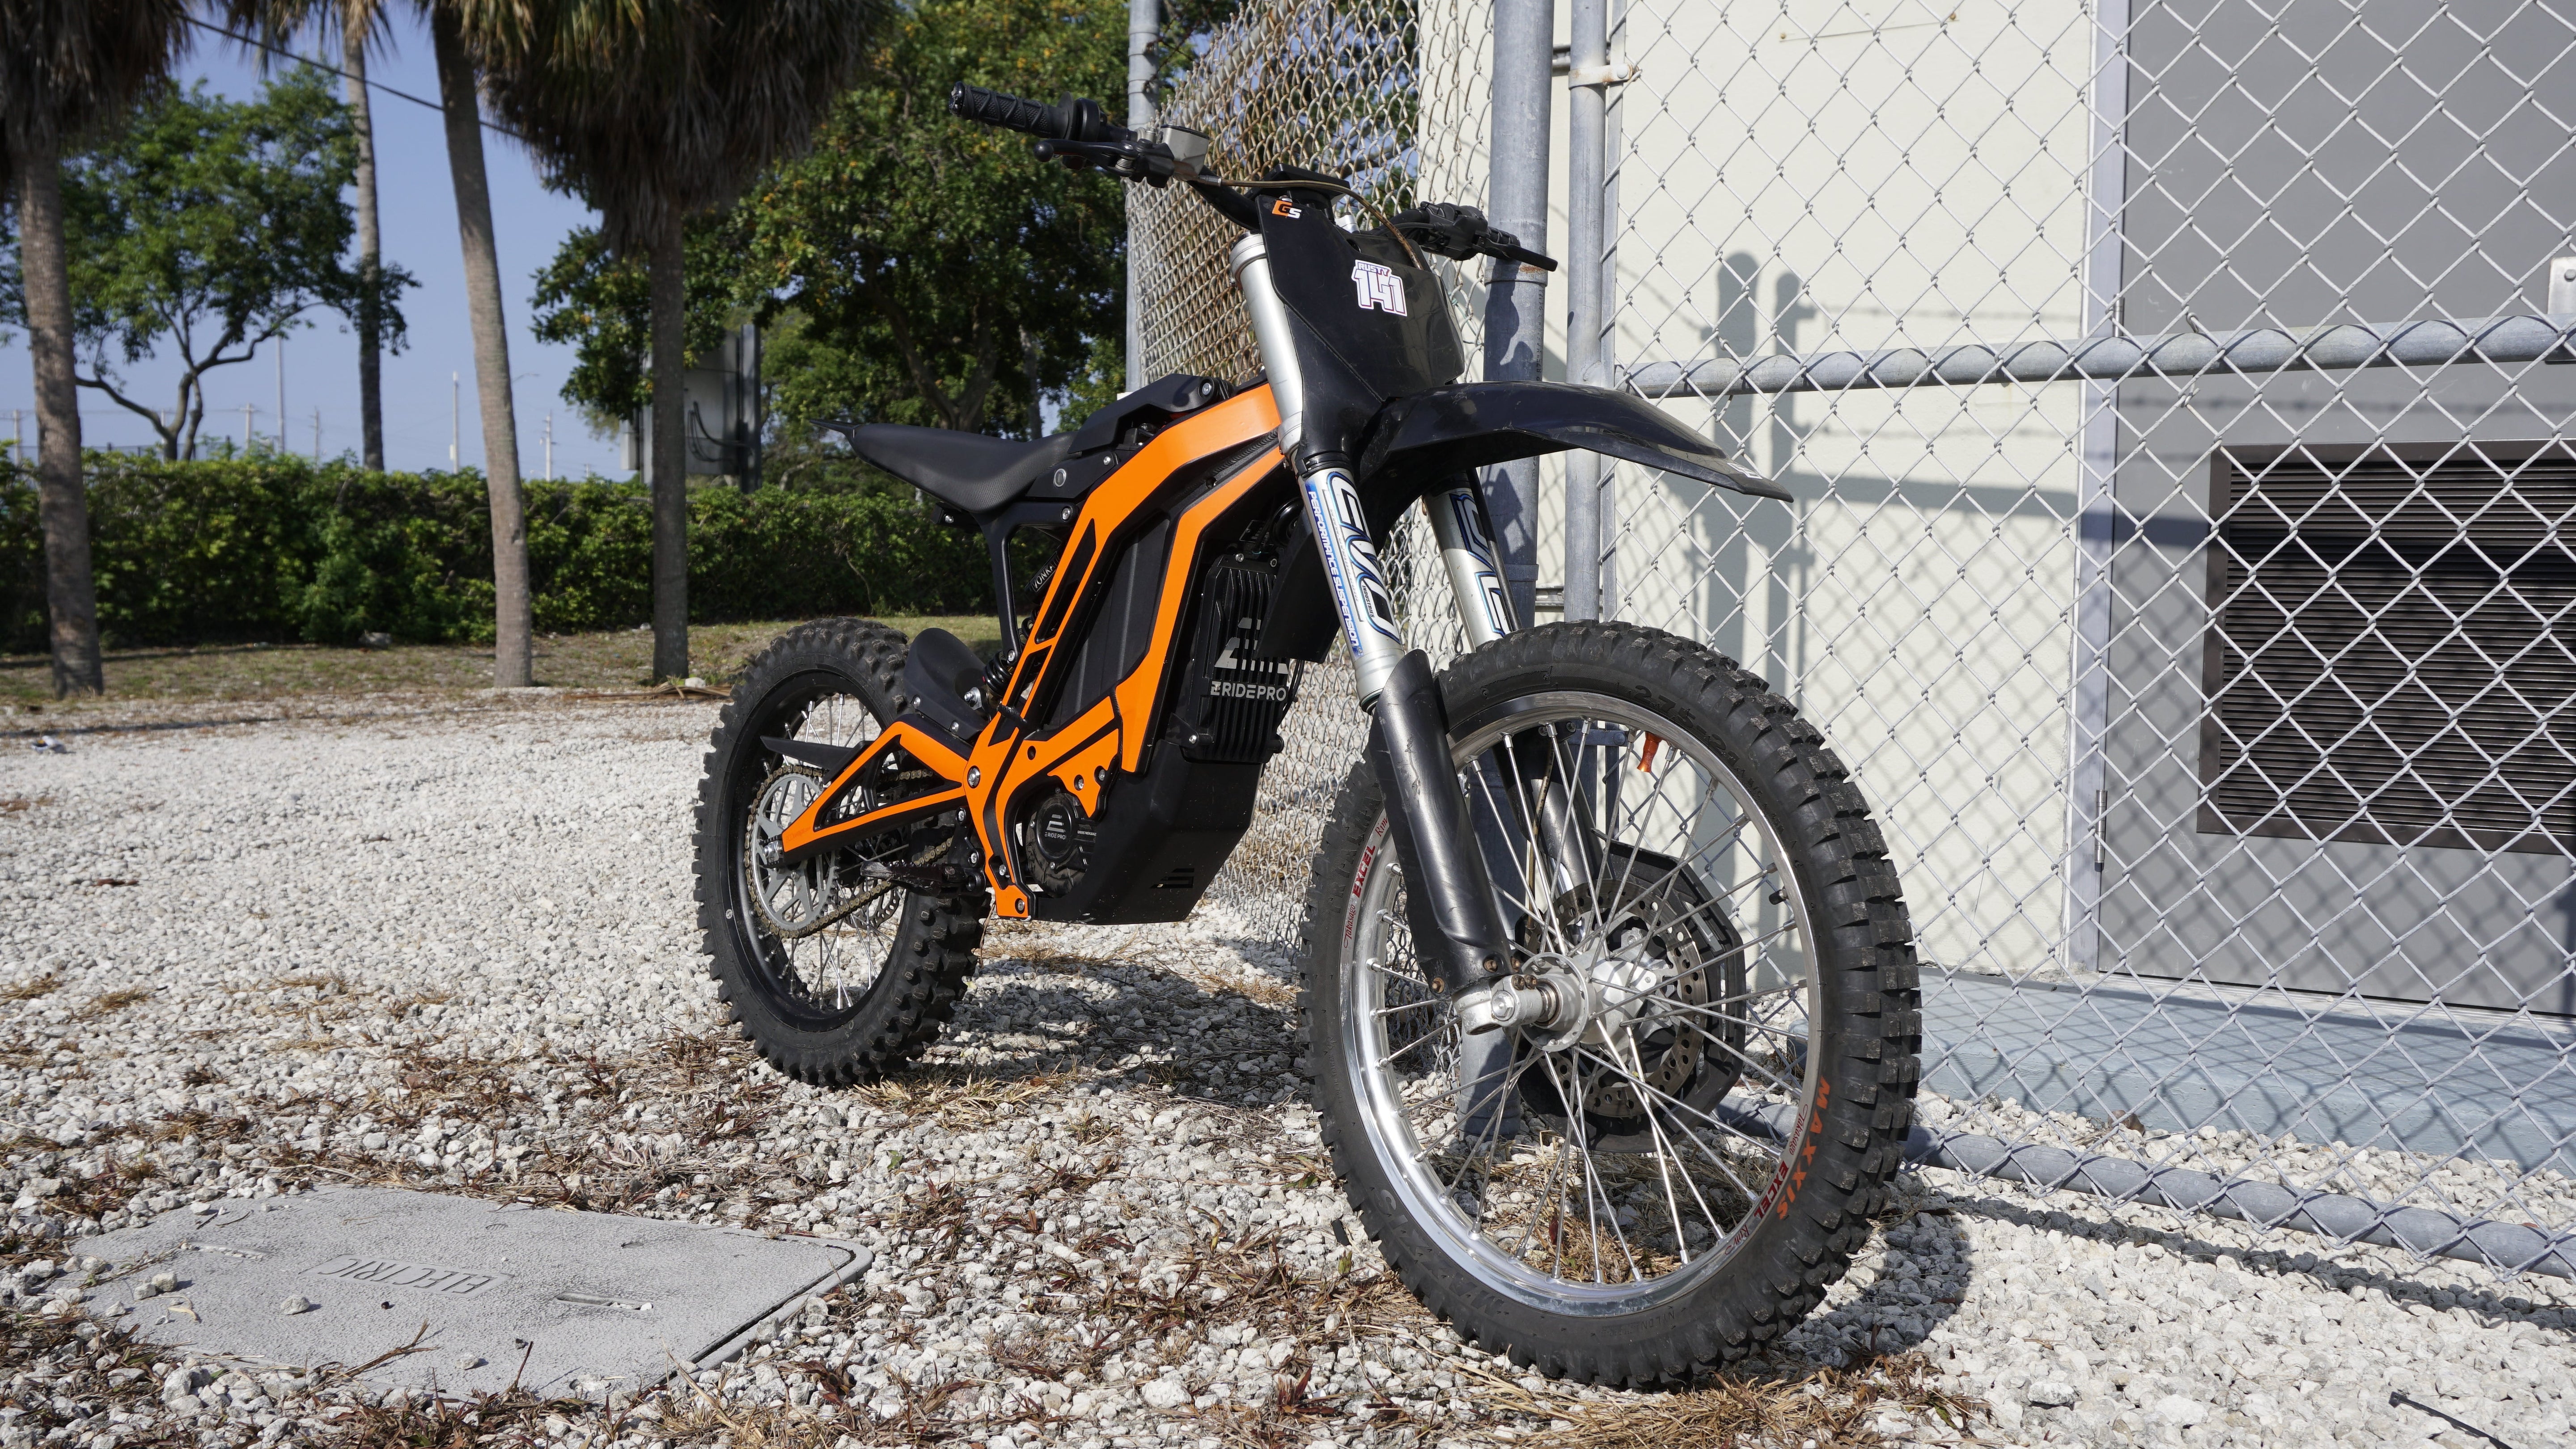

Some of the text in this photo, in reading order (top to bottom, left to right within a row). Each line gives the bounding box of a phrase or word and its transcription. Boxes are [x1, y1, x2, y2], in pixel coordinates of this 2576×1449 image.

[1354, 269, 1405, 314] 141
[1358, 262, 1390, 277] RUSTY
[1308, 491, 1360, 646] PERFORMANCE SUSPENSION
[1361, 585, 1374, 618] INDUSTRIES
[1210, 680, 1287, 701] ERIDEPRO
[1343, 815, 1388, 948] Takasago EXCEL Rim
[1776, 1076, 1830, 1220] MAXXIS
[1789, 1104, 1808, 1156] Takasago
[1754, 1161, 1789, 1219] EXCEL
[318, 1258, 498, 1294] ELECTRIC
[1374, 1189, 1505, 1316] MAXXIS
[1640, 1310, 1676, 1331] NYLON
